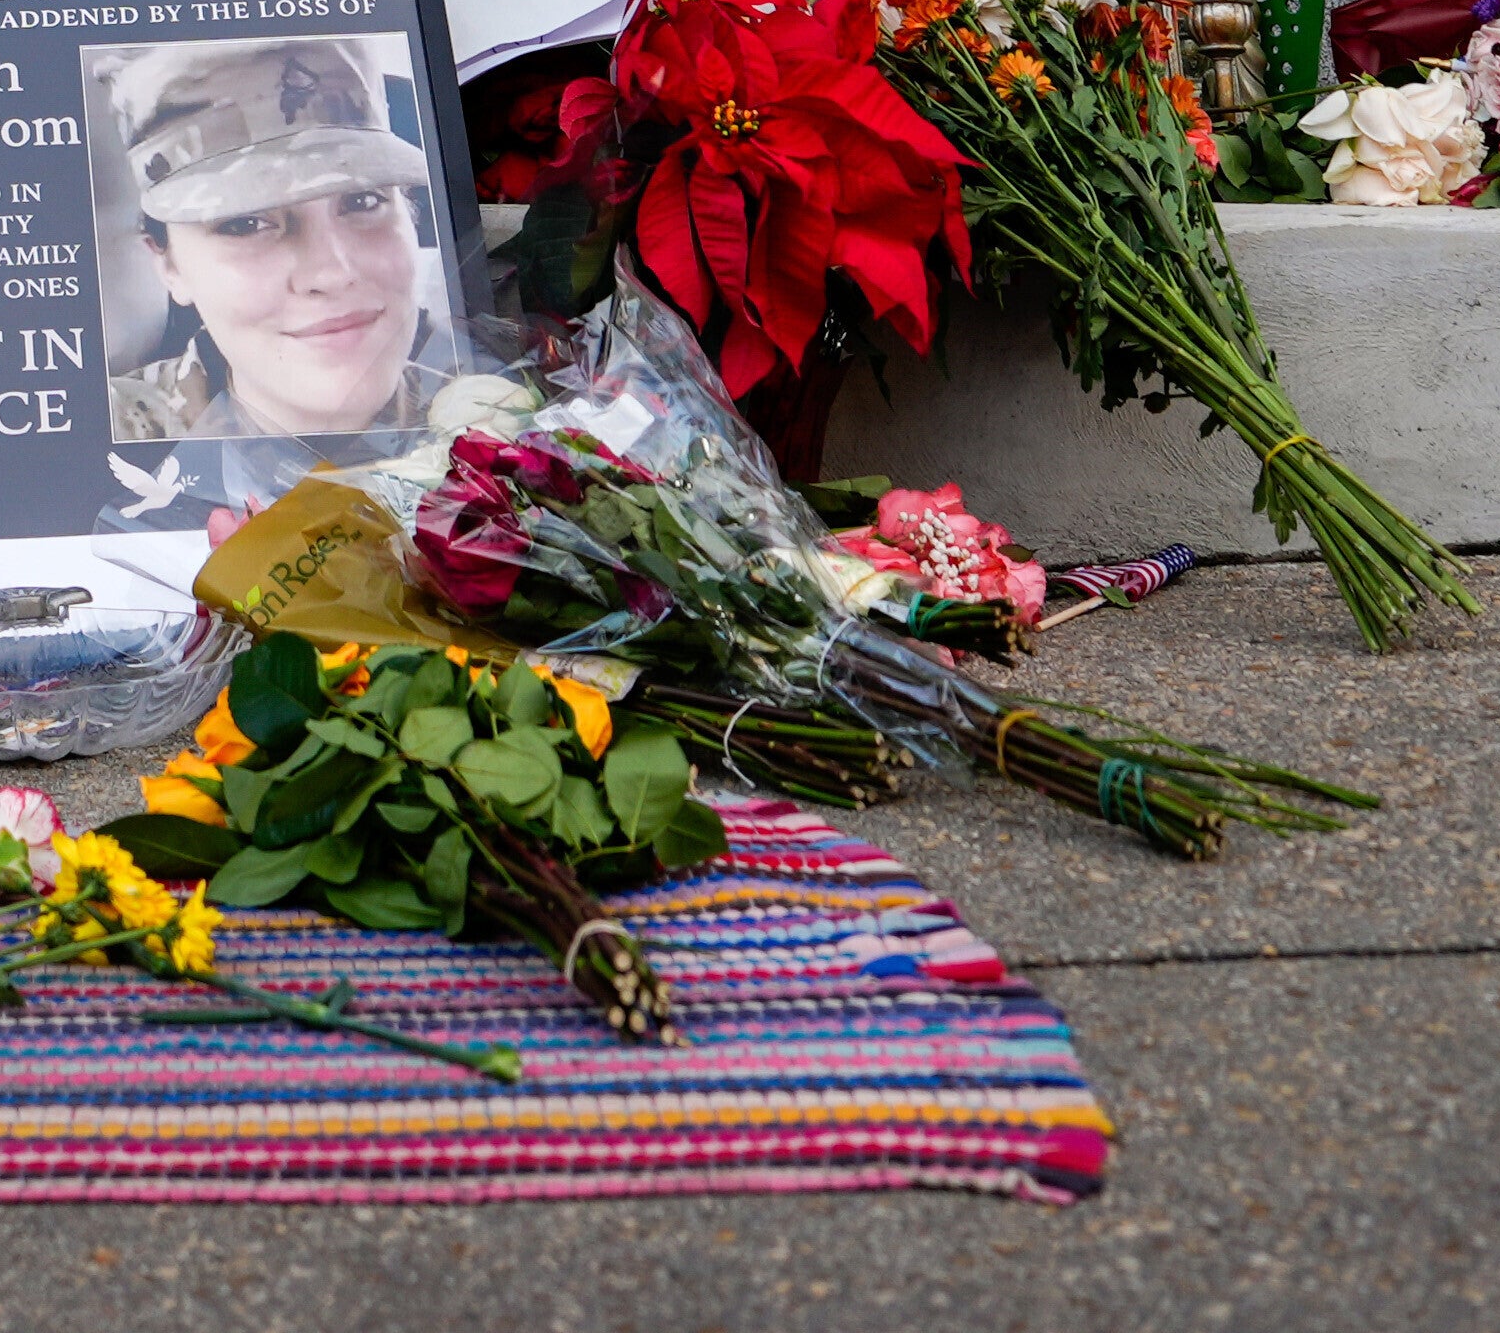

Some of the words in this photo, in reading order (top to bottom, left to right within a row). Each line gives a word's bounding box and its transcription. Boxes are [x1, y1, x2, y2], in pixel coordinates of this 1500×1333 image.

[146, 4, 184, 24] BY
[189, 1, 251, 22] THE
[9, 182, 43, 203] IN
[2, 276, 81, 299] ONES
[17, 327, 85, 372] IN
